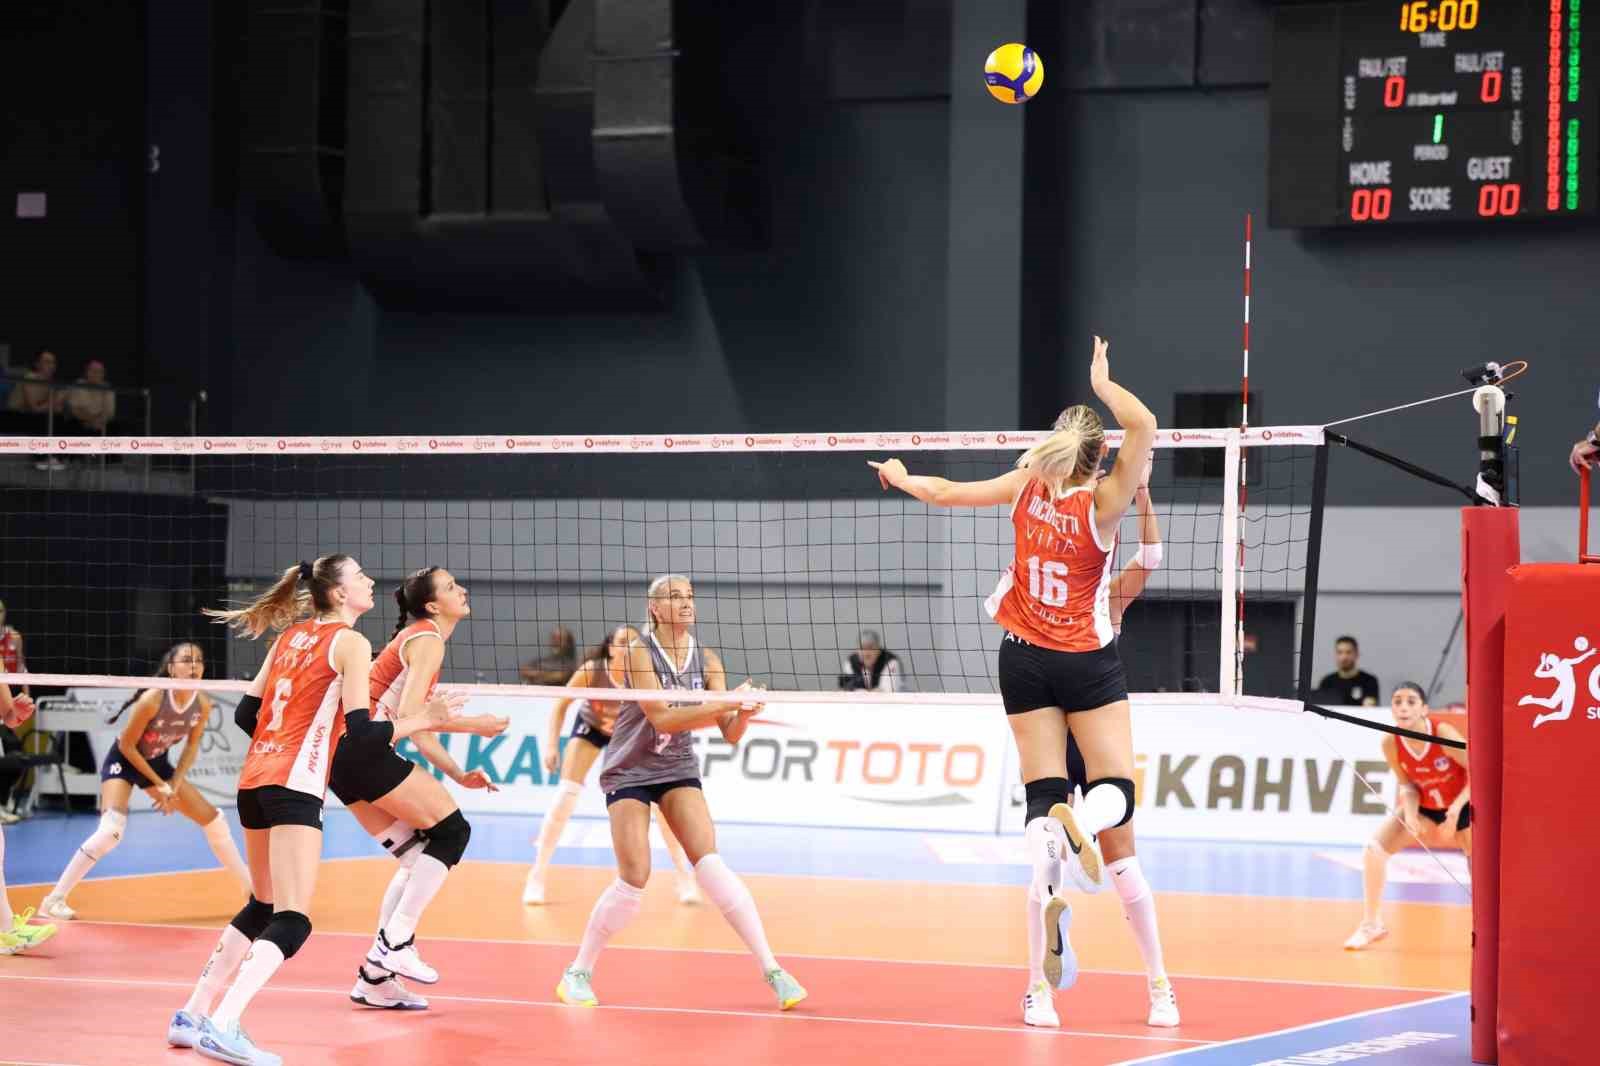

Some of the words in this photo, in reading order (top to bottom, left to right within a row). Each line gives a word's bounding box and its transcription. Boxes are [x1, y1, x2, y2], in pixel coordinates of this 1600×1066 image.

[1400, 0, 1479, 32] 16:00
[1420, 32, 1446, 47] TIME
[1384, 76, 1405, 107] 0
[1481, 71, 1503, 102] 0
[1350, 161, 1392, 185] HOME
[1467, 157, 1512, 180] GUEST
[1351, 188, 1392, 221] 00
[1409, 187, 1452, 211] SCORE
[1478, 184, 1521, 216] 00
[1027, 555, 1069, 607] 16
[266, 678, 293, 732] 6
